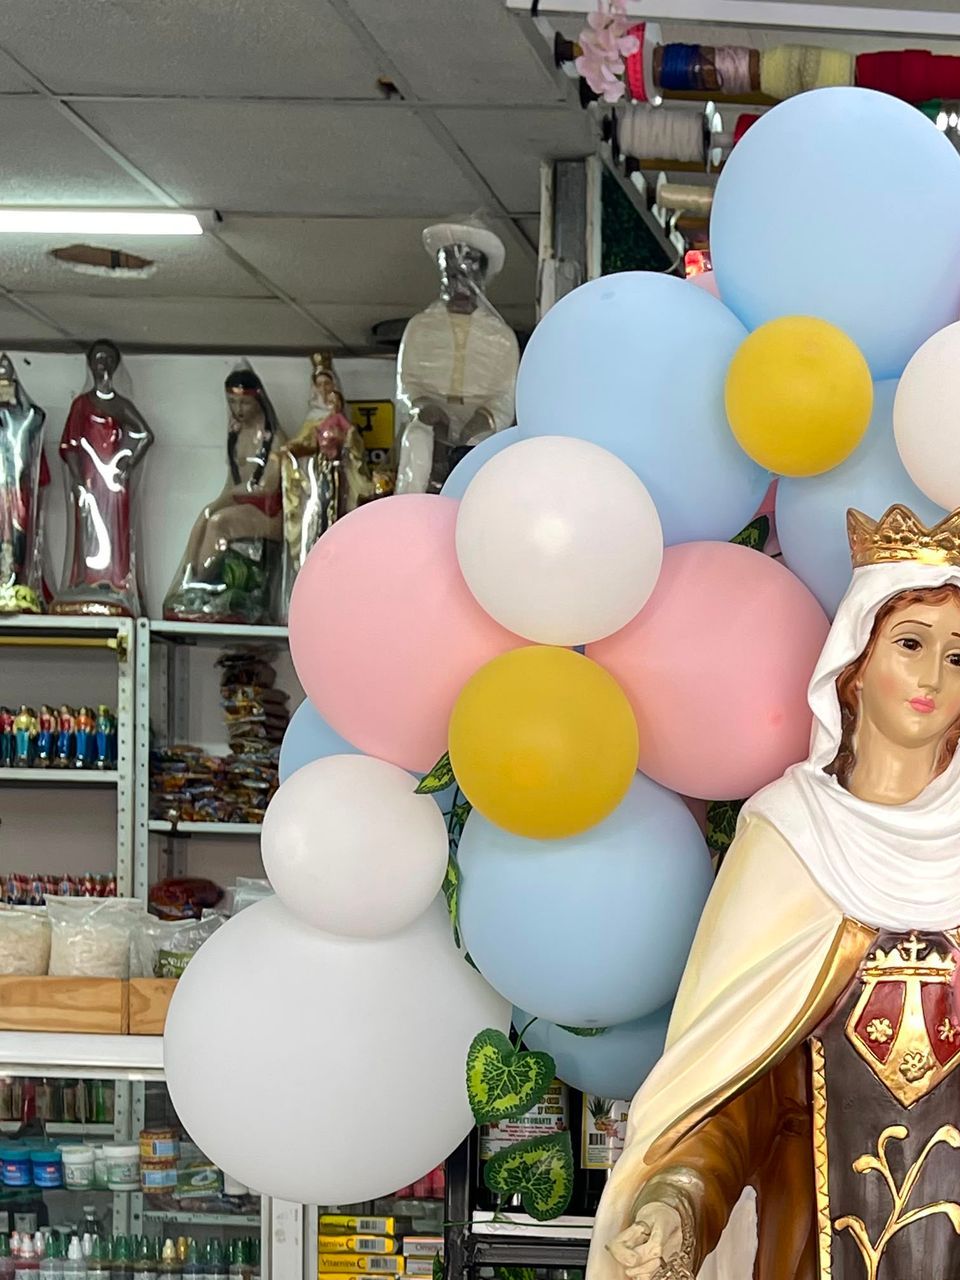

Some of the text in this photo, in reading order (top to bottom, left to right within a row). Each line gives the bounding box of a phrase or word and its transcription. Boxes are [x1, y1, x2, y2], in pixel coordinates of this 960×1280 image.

[346, 1238, 355, 1250] C
[321, 1257, 366, 1269] Vitamina C
